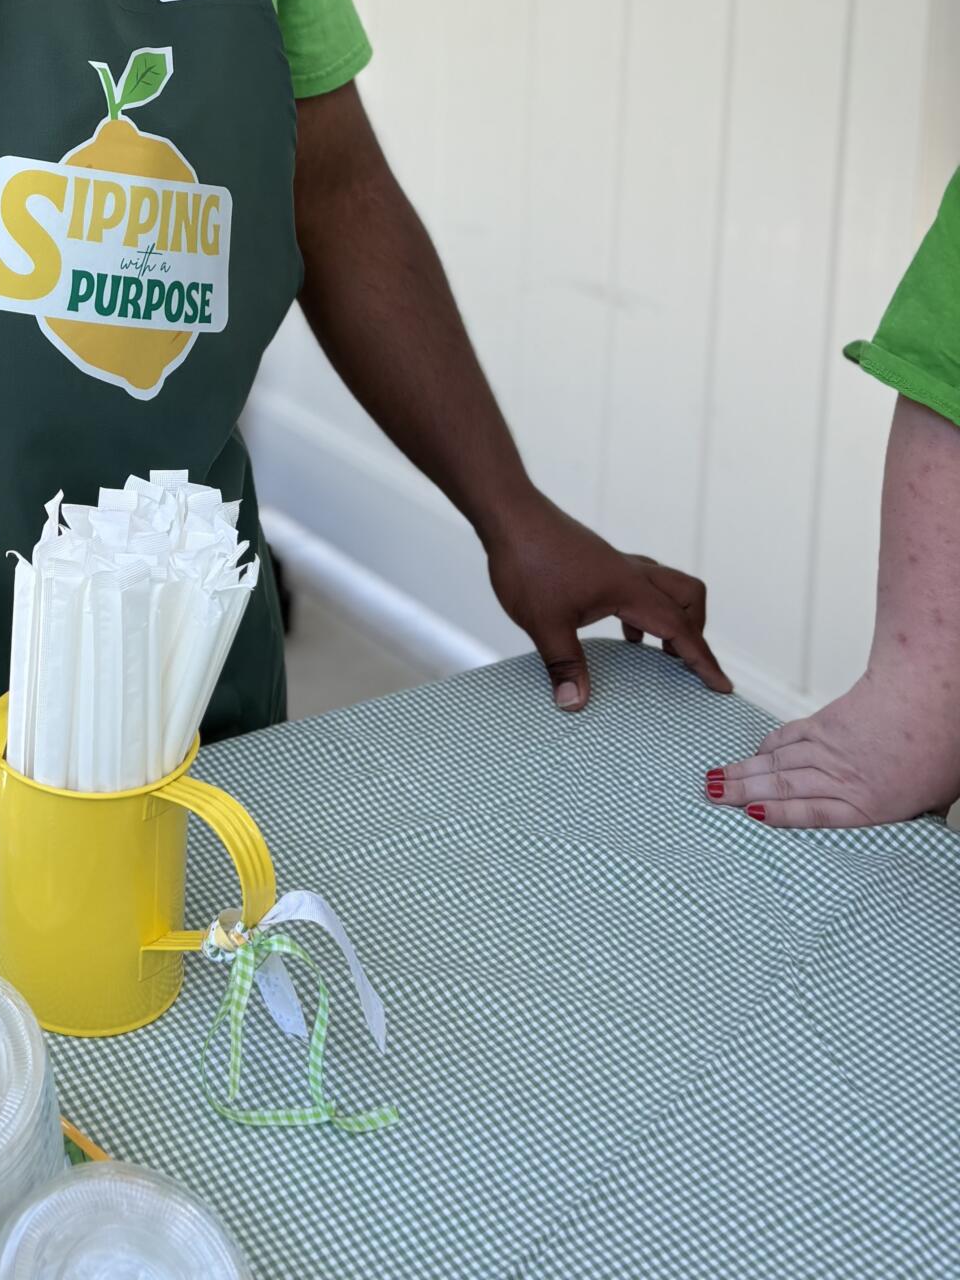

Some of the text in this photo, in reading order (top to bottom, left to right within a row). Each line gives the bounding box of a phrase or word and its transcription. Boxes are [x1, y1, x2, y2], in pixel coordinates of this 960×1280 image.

[120, 243, 171, 278] with a
[67, 269, 213, 324] PURPOSE
